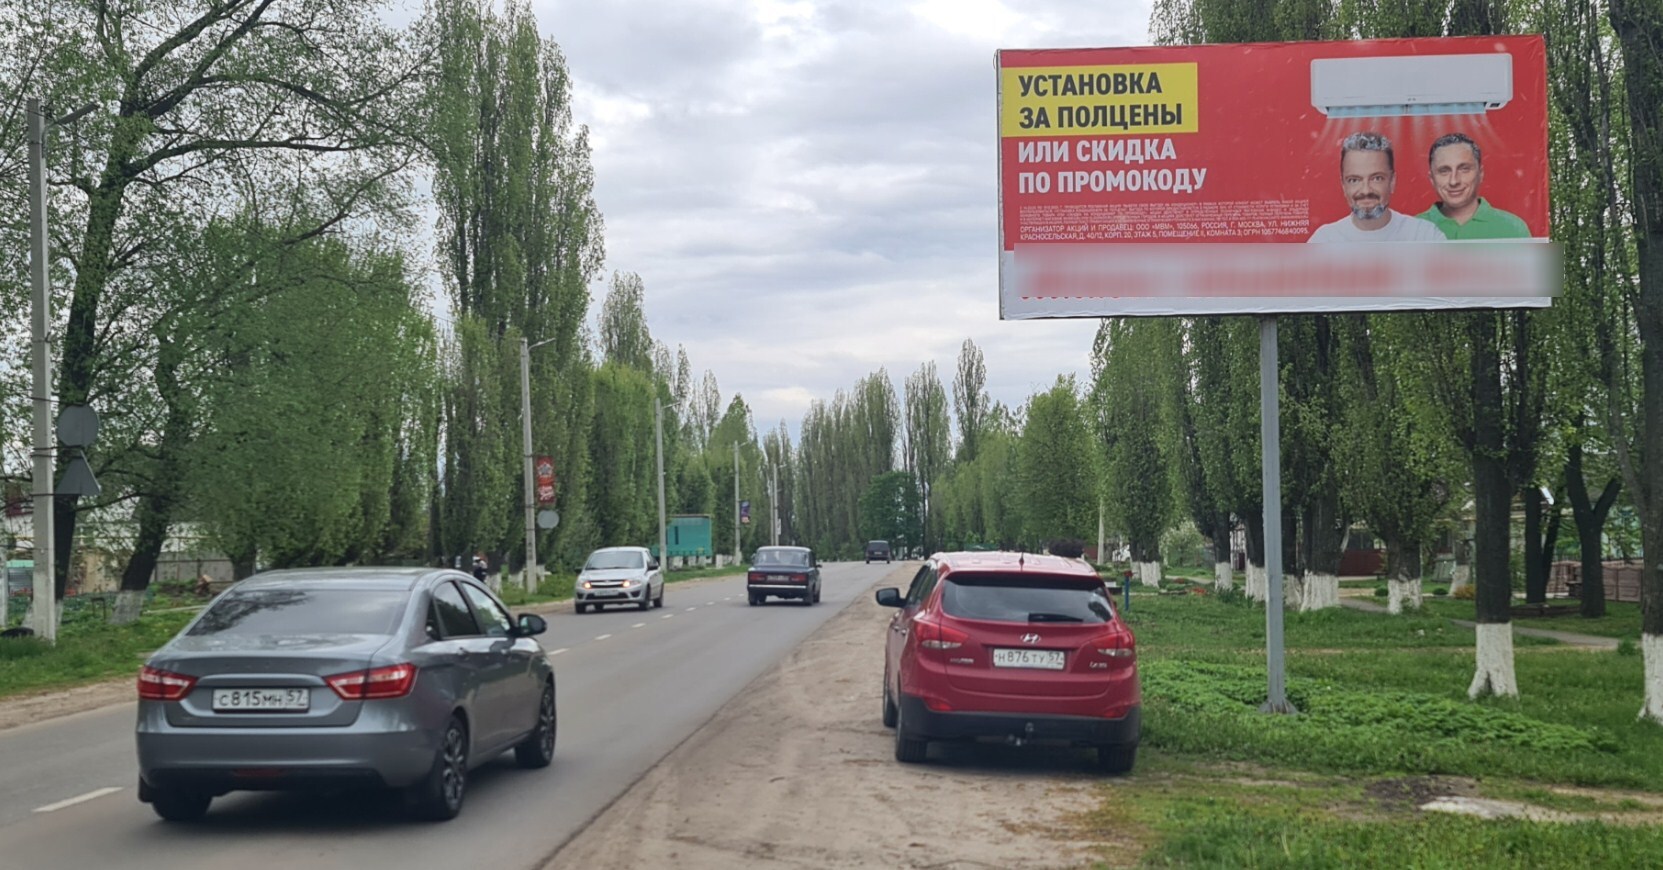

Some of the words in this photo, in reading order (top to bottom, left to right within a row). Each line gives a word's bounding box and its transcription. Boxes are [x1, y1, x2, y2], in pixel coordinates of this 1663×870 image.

[1018, 72, 1162, 97] УСТАНОВКА
[1019, 107, 1051, 129] ЗА
[1057, 103, 1182, 130] ПОЛЦЕНЫ
[1018, 141, 1069, 163] ИЛИ
[1076, 138, 1177, 164] СКИДКА
[1018, 172, 1050, 194] ПО
[1057, 168, 1207, 194] ПРОМОКОДУ
[1020, 225, 1064, 233] ОРГАНИЗАТОР
[1066, 223, 1089, 232] АКЦИЙ
[1136, 223, 1150, 231] ООО
[1280, 219, 1309, 227] НИЖНЯЯ
[1134, 230, 1151, 239] ЭТАЖ
[1159, 230, 1200, 238] ПОМЕЩЕНИЕ
[1207, 229, 1237, 237] КОМНАТА
